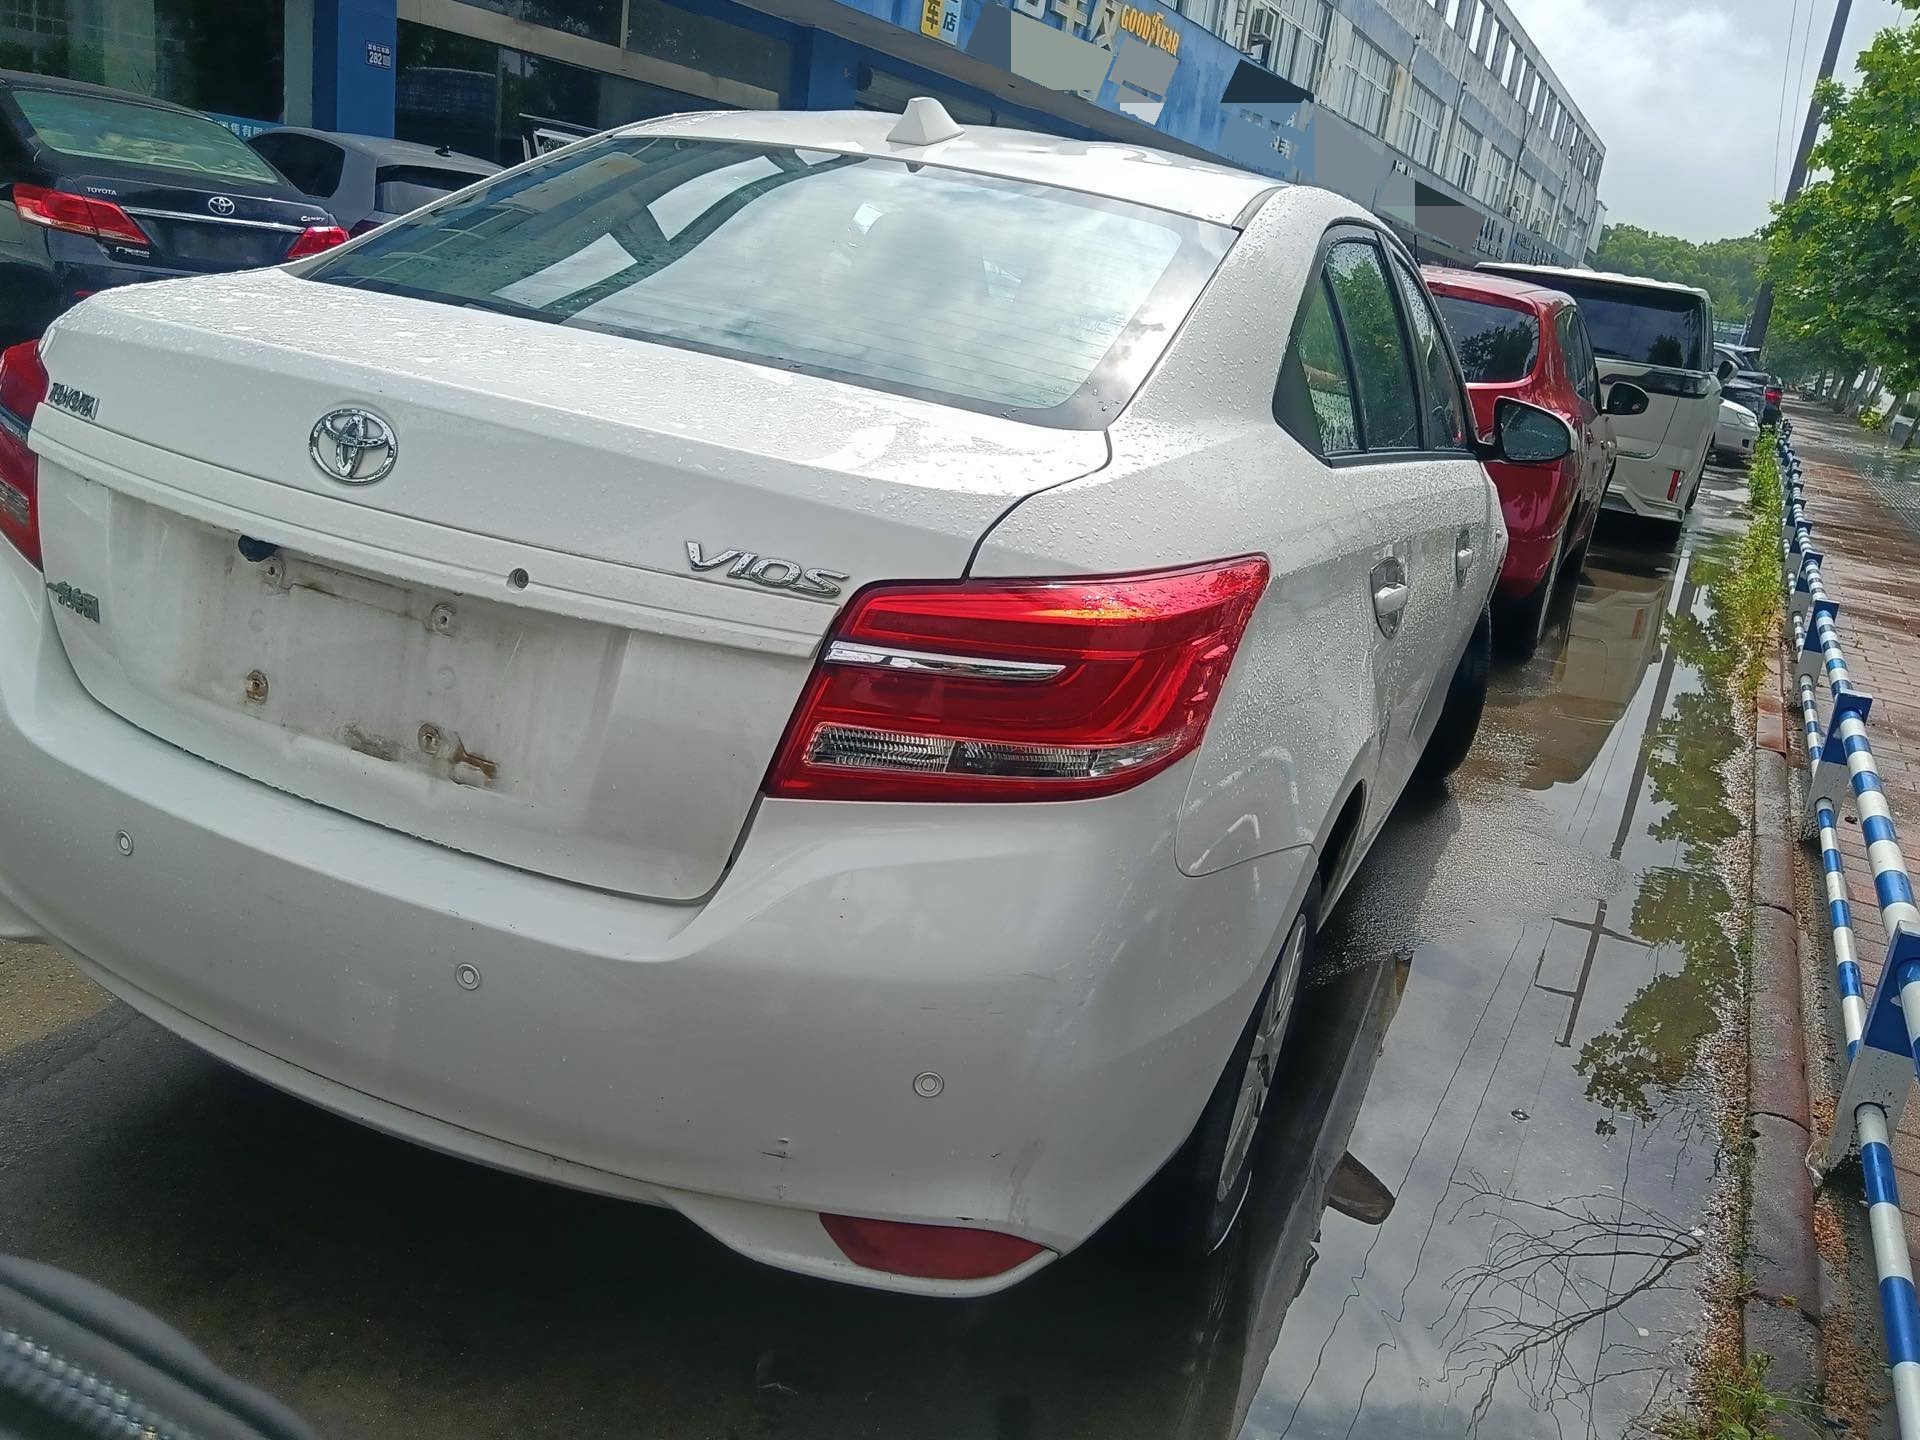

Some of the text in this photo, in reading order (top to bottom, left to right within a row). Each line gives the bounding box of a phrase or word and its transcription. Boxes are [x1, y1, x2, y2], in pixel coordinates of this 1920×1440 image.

[1119, 4, 1180, 57] GOODYEAR
[369, 51, 383, 65] 282
[86, 186, 117, 196] TOYOTA
[48, 382, 100, 420] TOYOTA
[686, 540, 850, 599] VIOS
